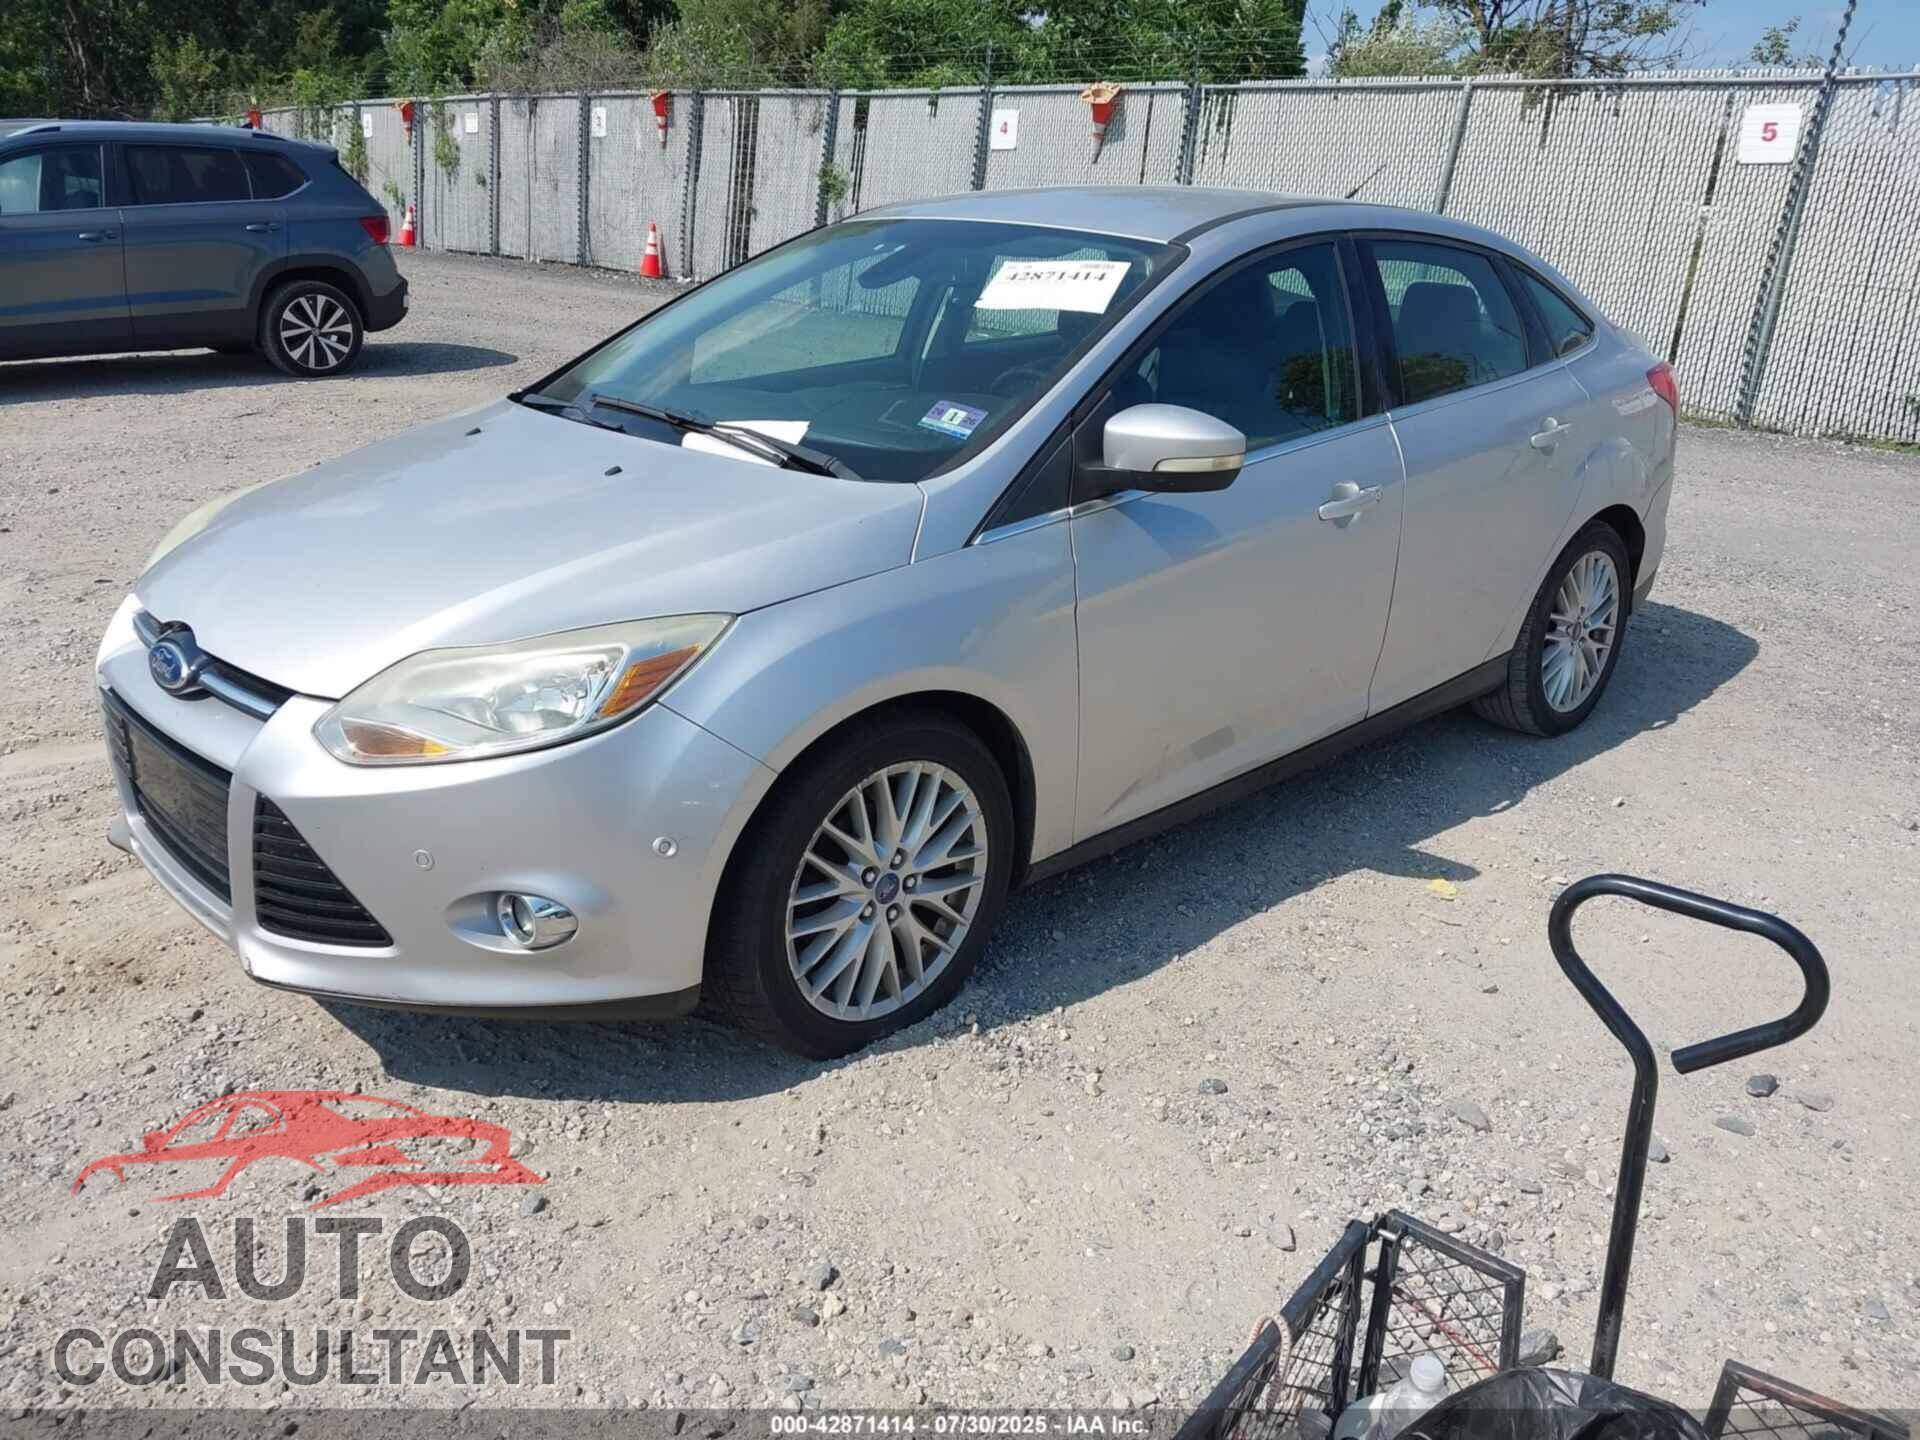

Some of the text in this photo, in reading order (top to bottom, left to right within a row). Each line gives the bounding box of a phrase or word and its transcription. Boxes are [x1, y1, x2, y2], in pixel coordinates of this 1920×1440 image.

[1000, 121, 1008, 134] 4
[1761, 122, 1779, 142] 5
[1006, 271, 1107, 281] 42871414
[949, 411, 959, 422] 1
